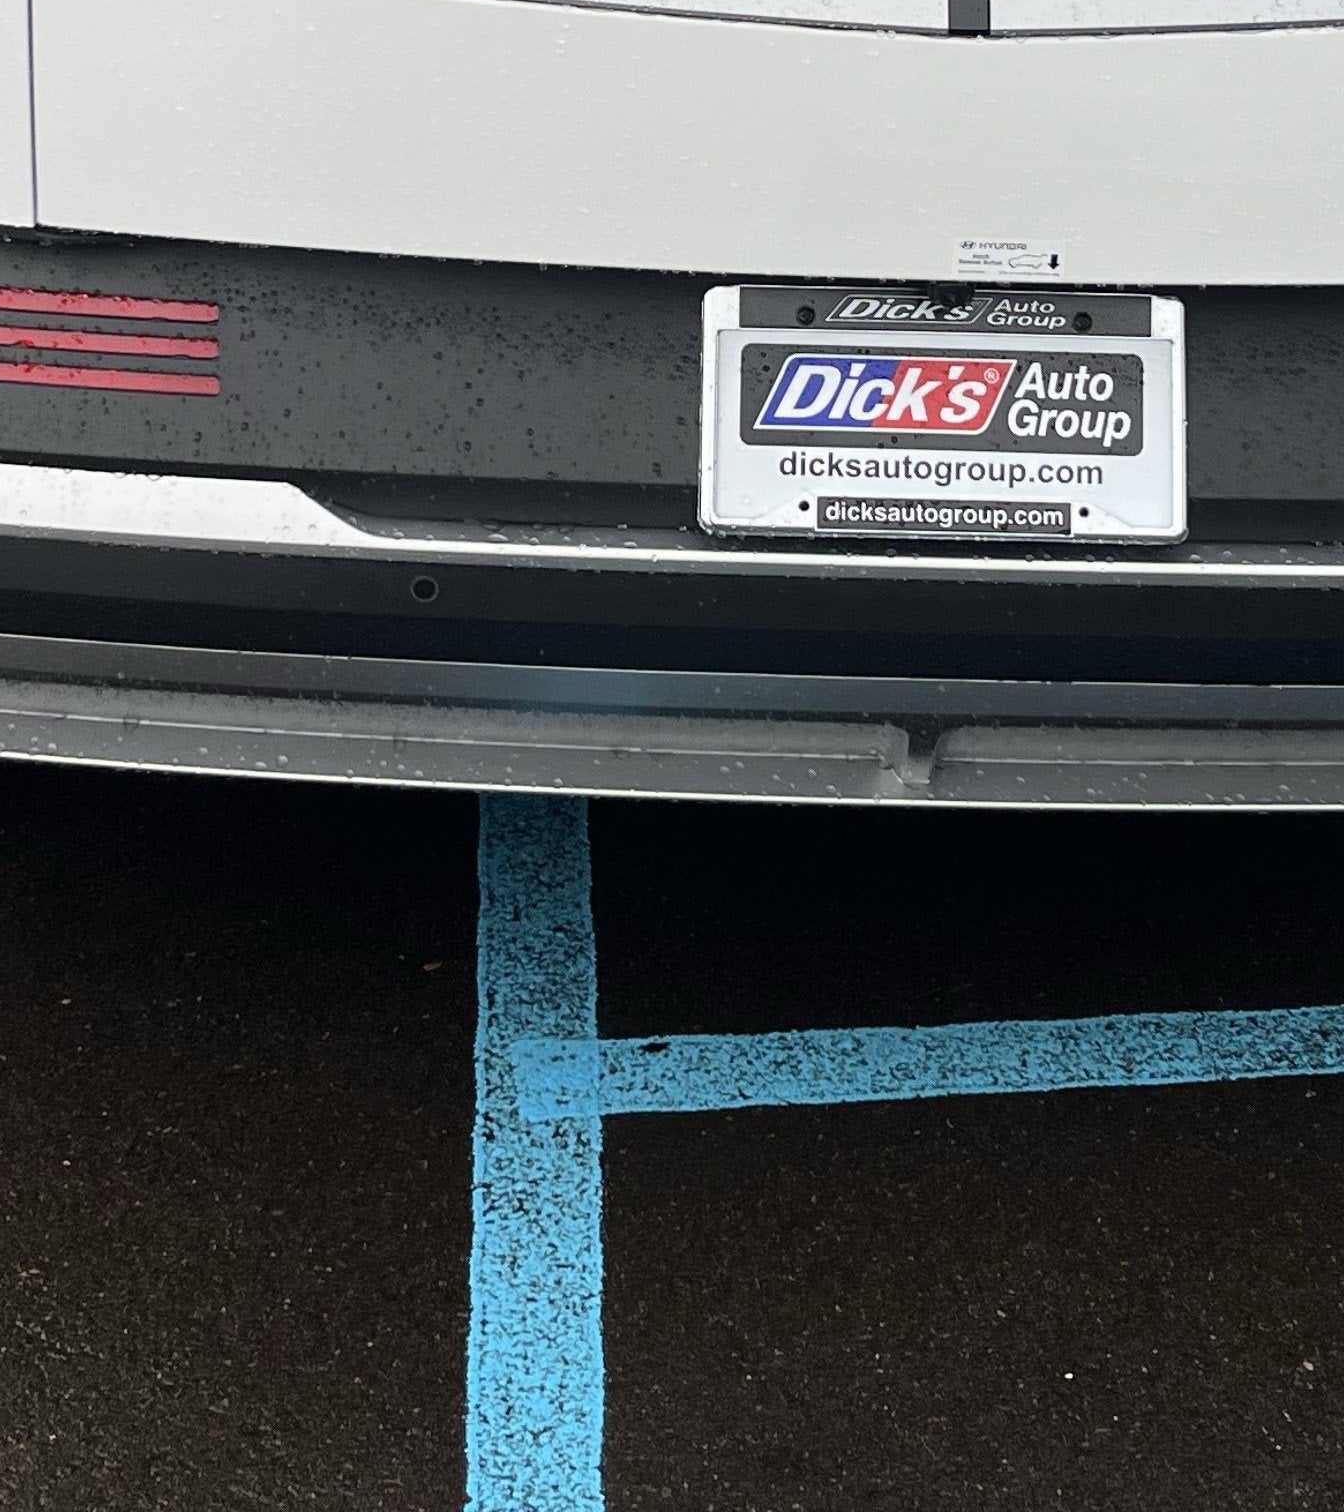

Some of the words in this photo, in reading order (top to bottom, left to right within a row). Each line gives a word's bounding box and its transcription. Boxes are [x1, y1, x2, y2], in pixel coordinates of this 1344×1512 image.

[986, 311, 1068, 330] Group
[994, 298, 1056, 314] Auto
[1014, 361, 1115, 402] Auto
[1006, 398, 1132, 448] Group
[778, 451, 1104, 489] dicksautogroup.com
[823, 501, 1066, 528] dicksautogroup.com
